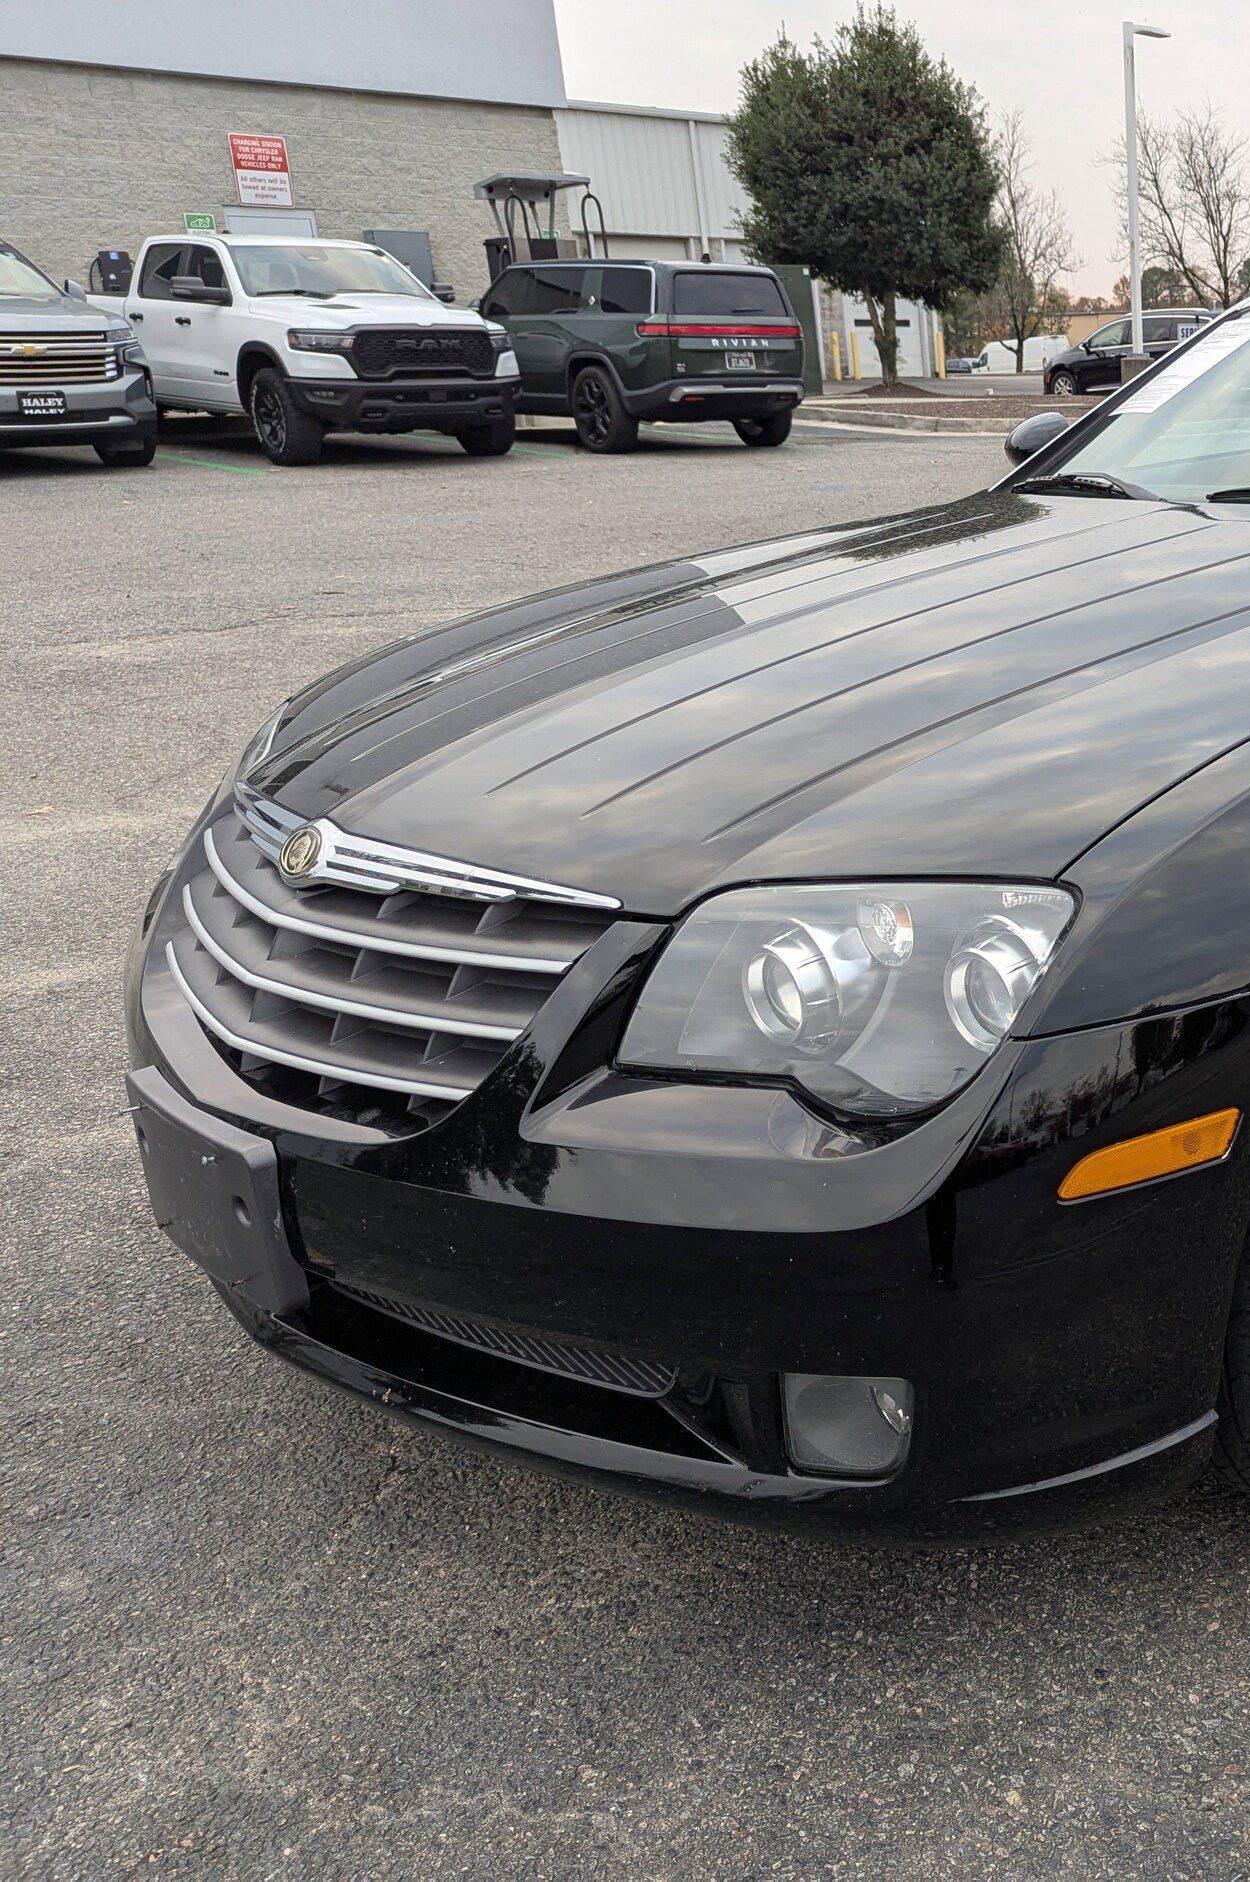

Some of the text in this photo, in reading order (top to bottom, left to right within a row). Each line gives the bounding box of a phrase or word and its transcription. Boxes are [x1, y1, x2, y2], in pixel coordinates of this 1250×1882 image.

[233, 138, 282, 148] CHARGING STATION
[251, 146, 278, 155] CHRYSLER
[240, 161, 266, 169] VEHICLES
[395, 339, 461, 351] RAM
[711, 338, 770, 347] RIVIAN
[22, 397, 64, 407] HALEY
